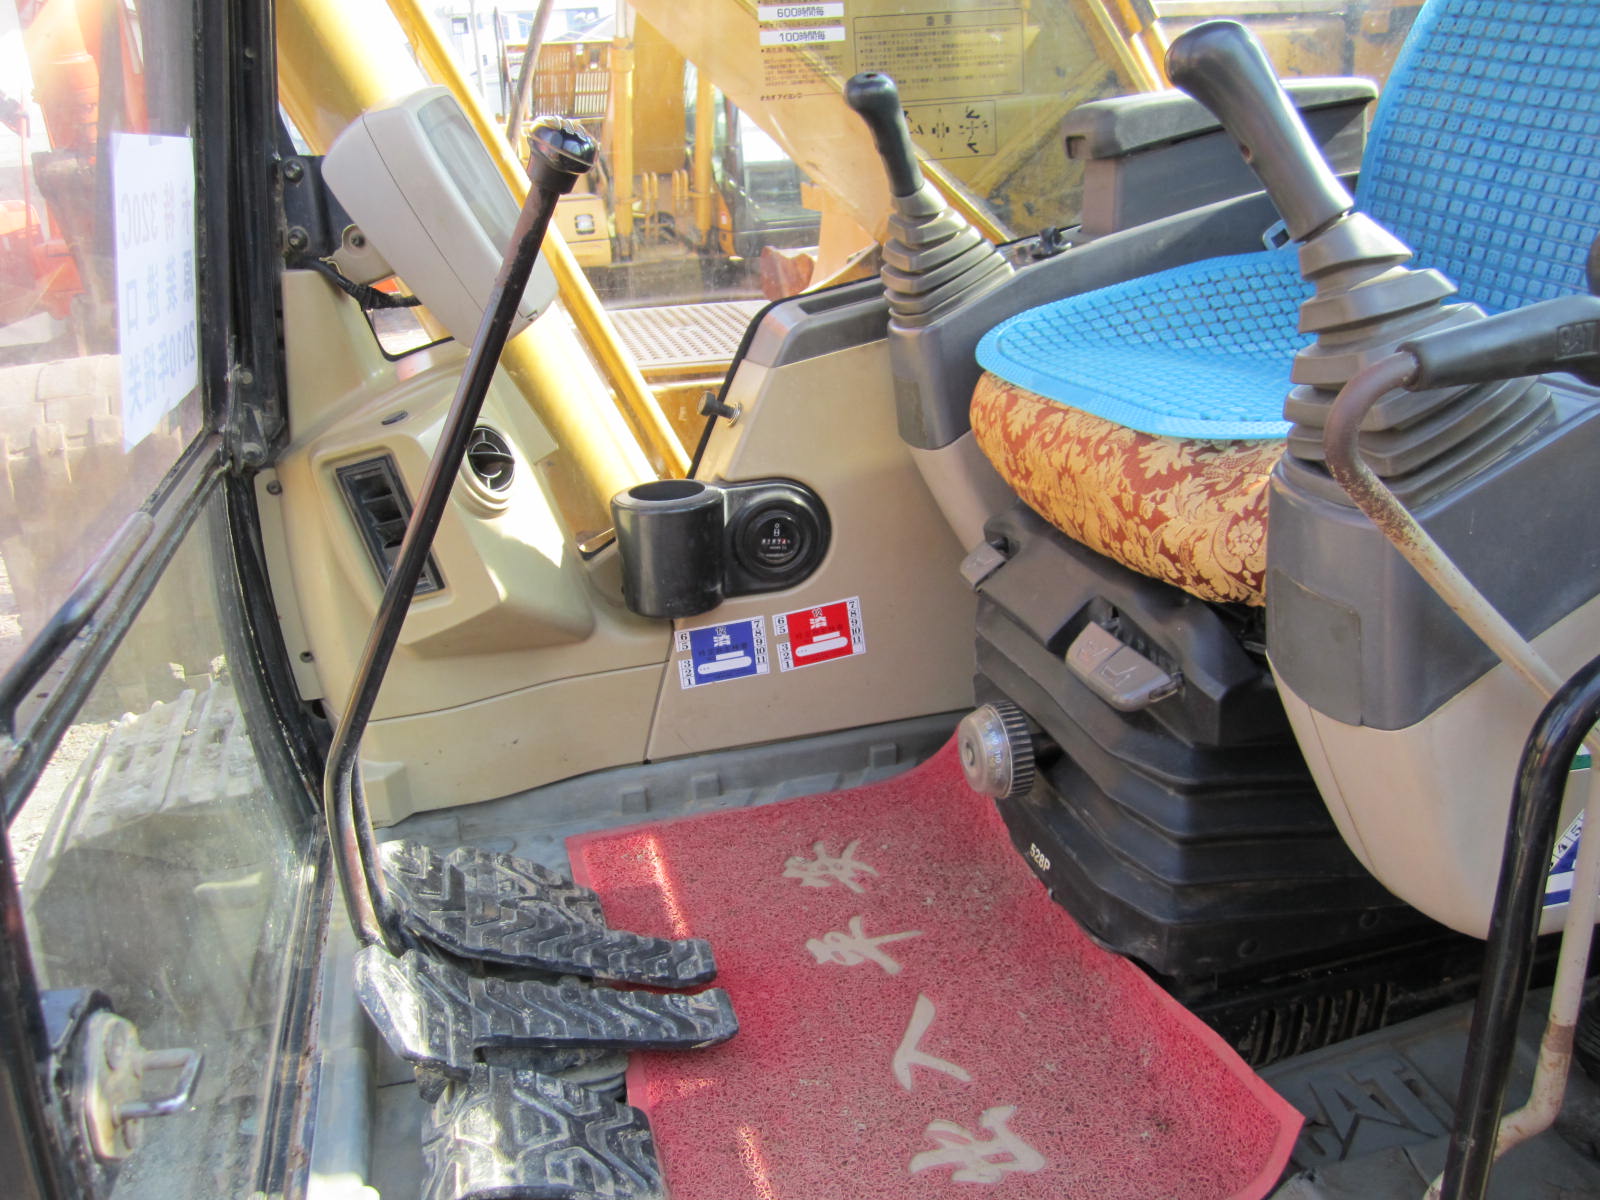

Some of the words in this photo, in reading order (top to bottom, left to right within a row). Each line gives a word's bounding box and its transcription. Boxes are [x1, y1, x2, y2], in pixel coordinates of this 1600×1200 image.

[777, 6, 824, 18] 600時間毎
[779, 30, 826, 42] 100時間毎
[754, 620, 760, 628] 7
[680, 633, 688, 641] 6
[1029, 842, 1051, 872] 528P
[782, 838, 1047, 1184] 出入平安
